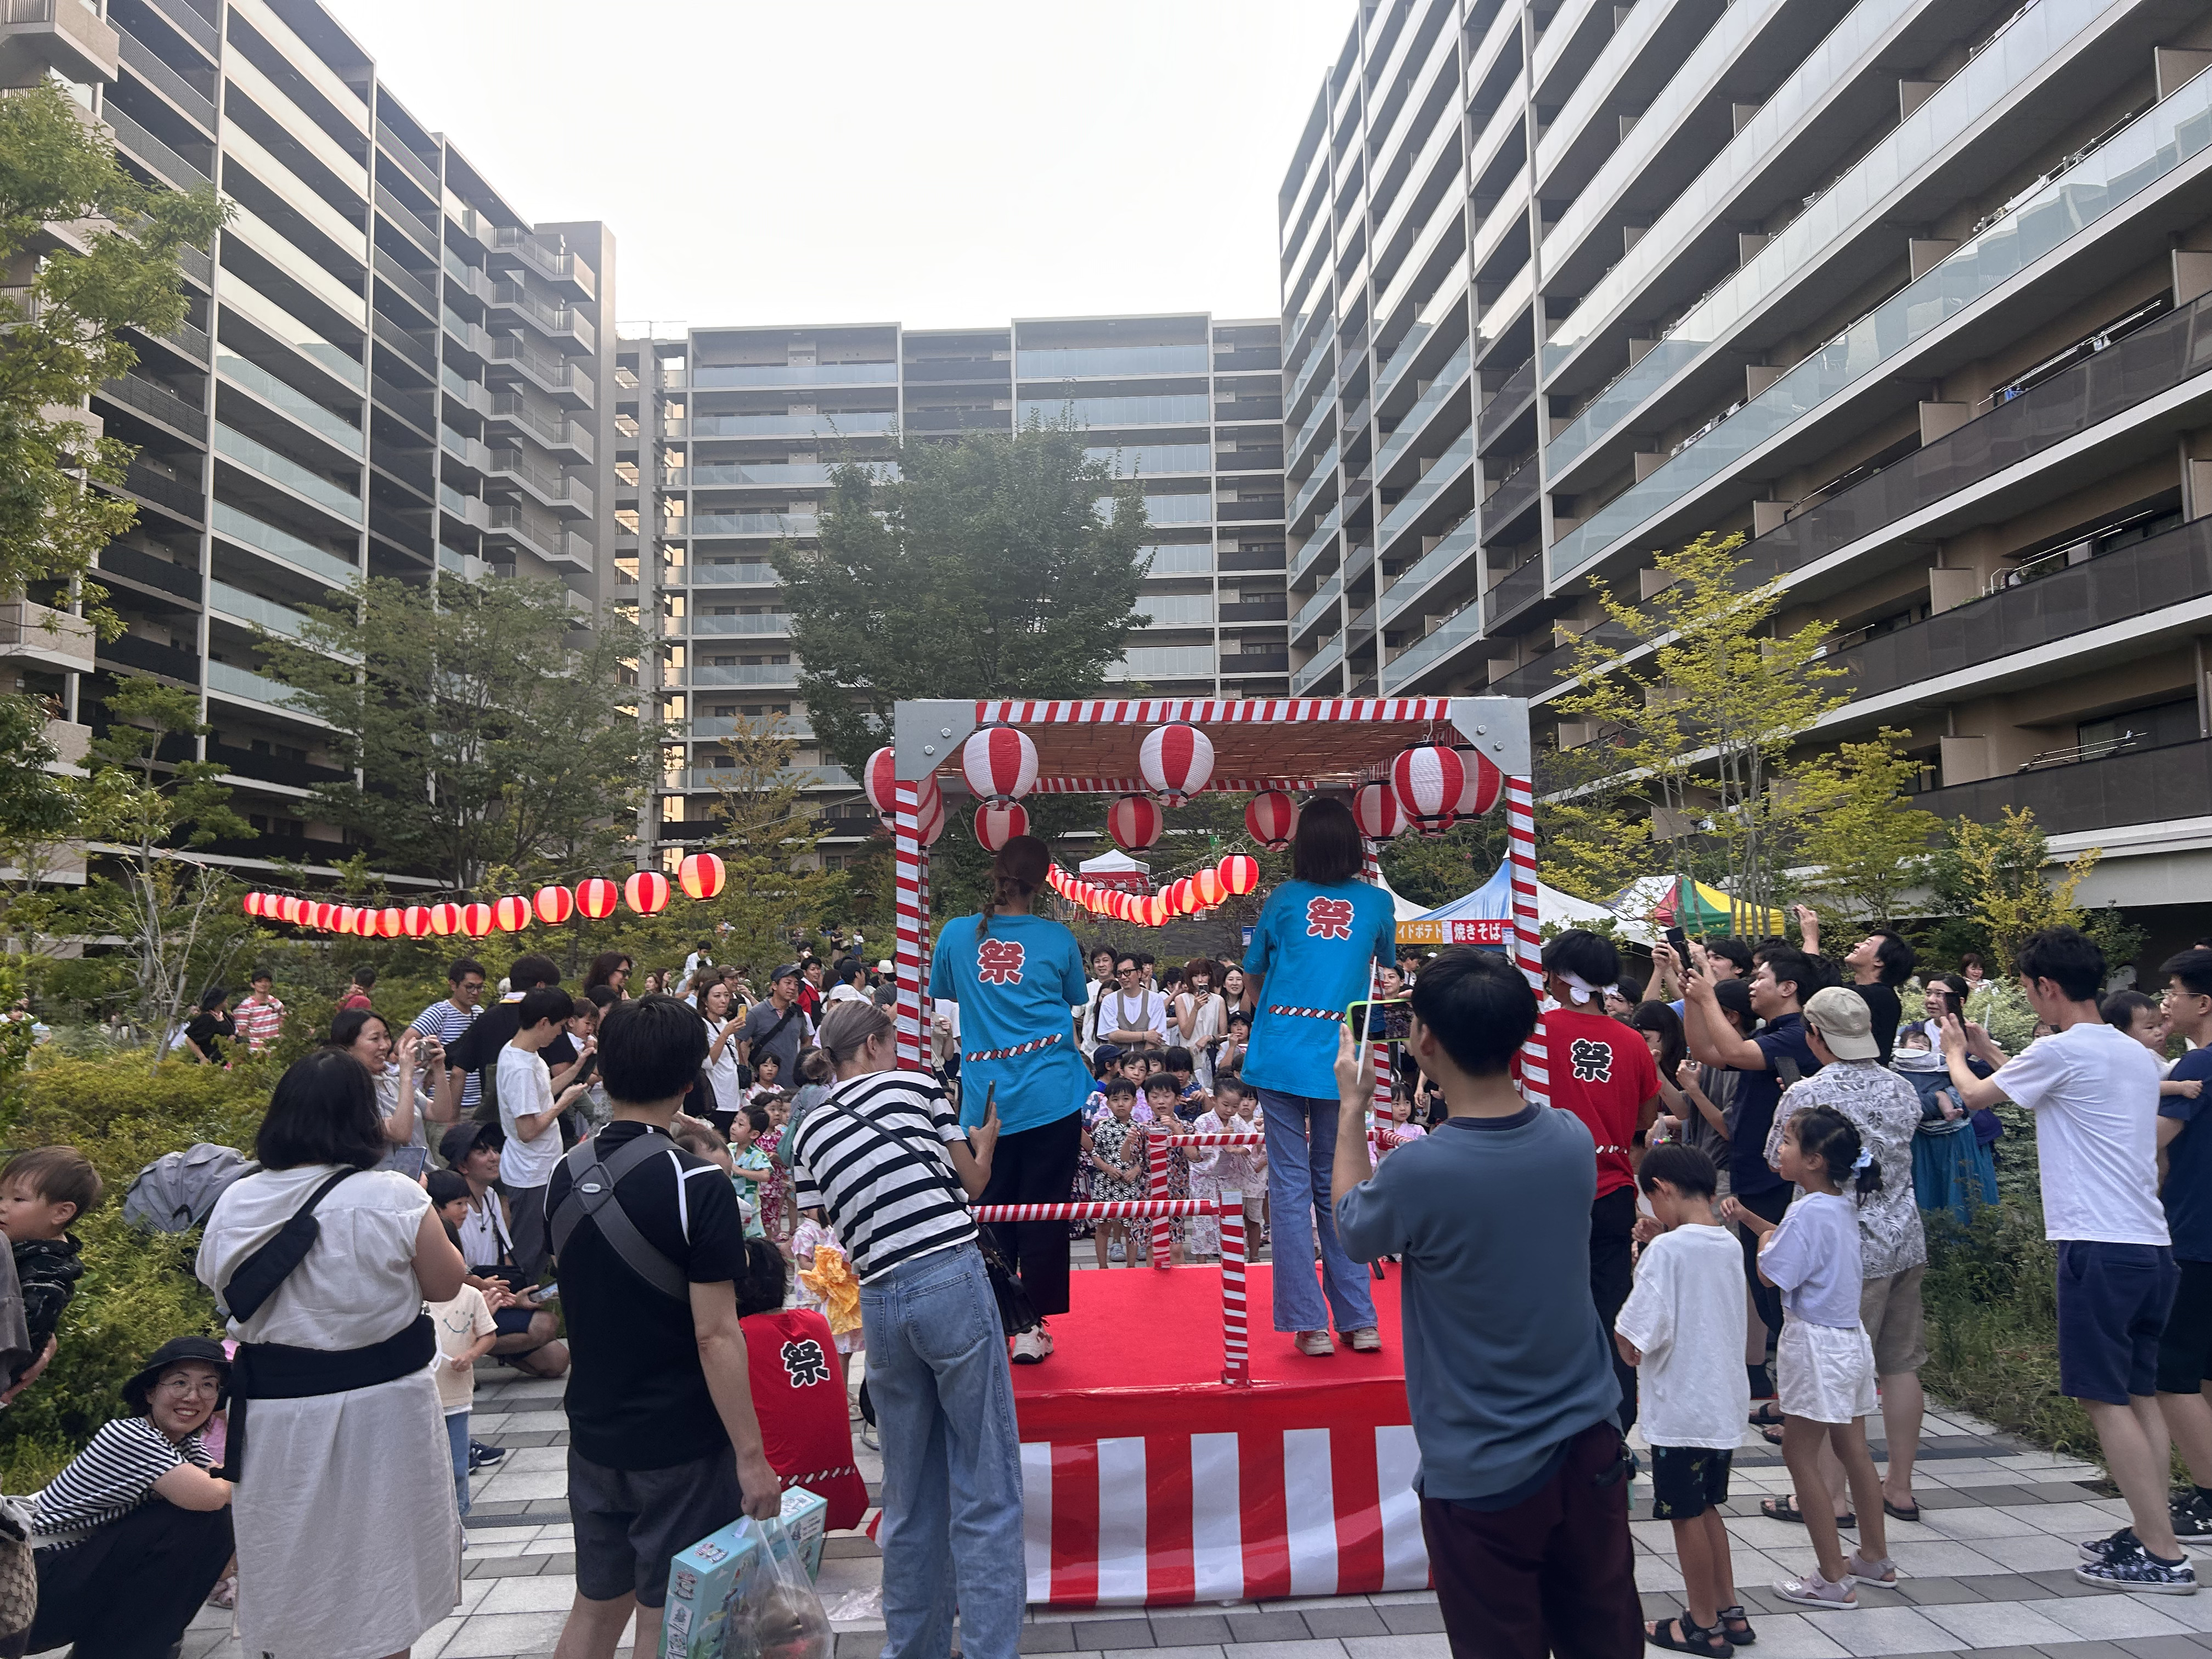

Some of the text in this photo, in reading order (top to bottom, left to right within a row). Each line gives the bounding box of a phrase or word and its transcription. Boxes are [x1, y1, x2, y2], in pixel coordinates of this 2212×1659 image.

[1305, 896, 1355, 941] 祭
[1398, 923, 1442, 939] イドポテト
[1453, 922, 1501, 941] 焼きそば
[977, 938, 1025, 984] 祭
[1570, 1038, 1614, 1082] 祭
[781, 1339, 830, 1388] 祭
